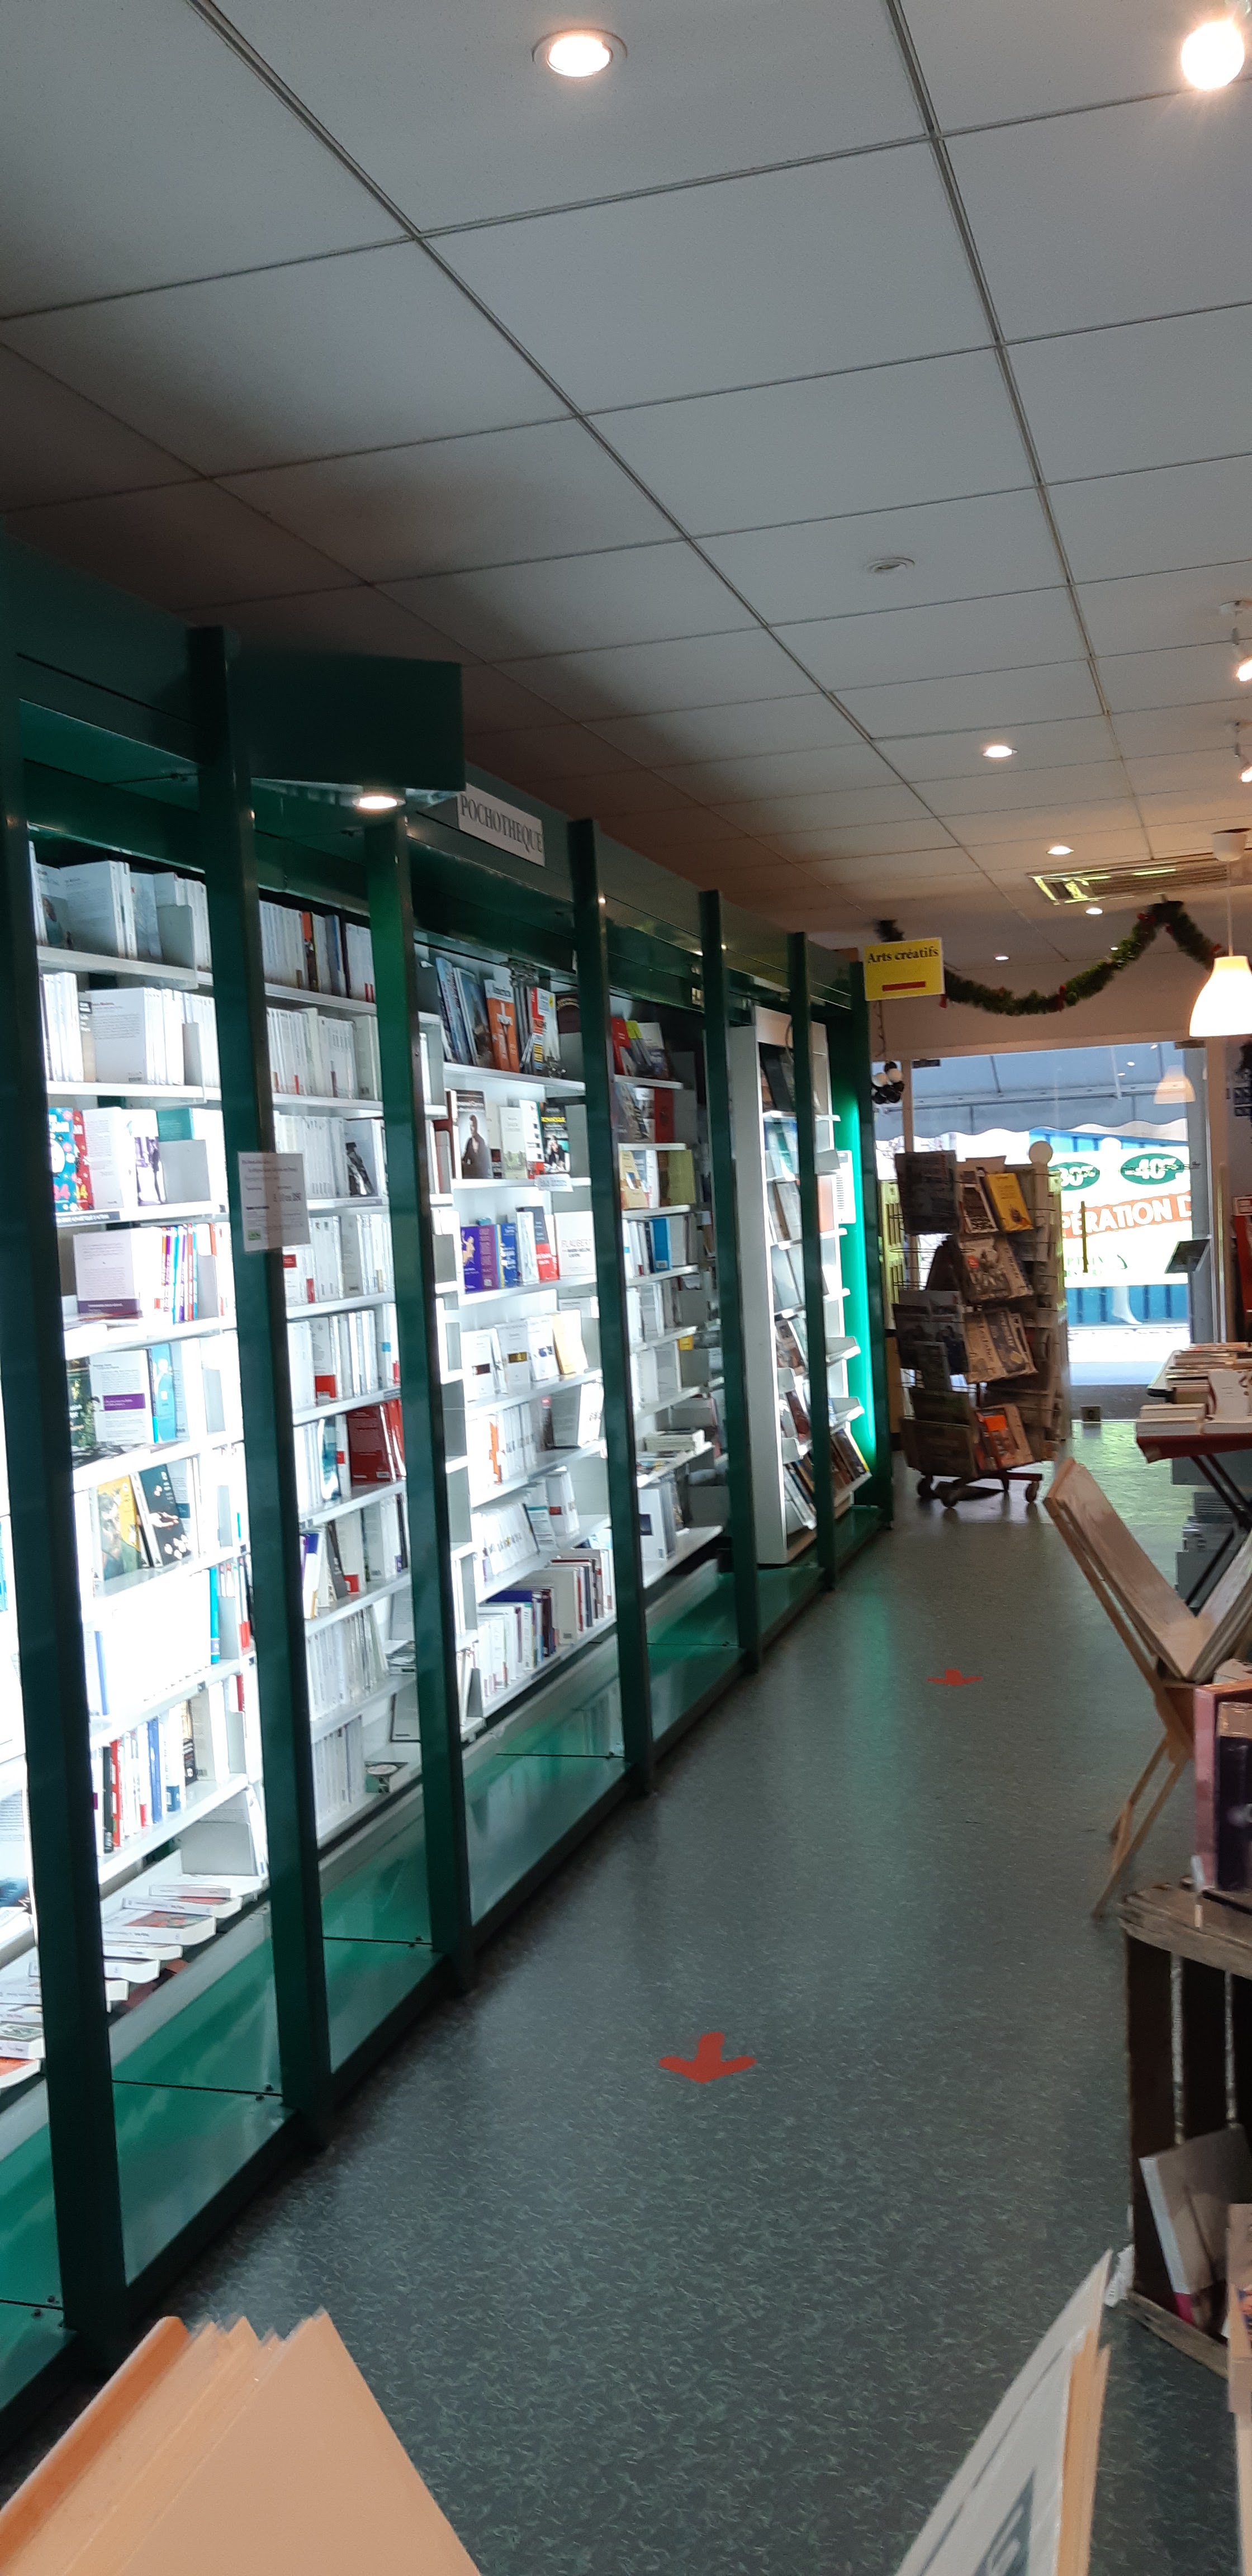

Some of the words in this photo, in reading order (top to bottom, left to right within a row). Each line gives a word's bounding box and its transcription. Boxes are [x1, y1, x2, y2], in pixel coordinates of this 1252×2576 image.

[461, 795, 542, 853] POCHOTHEQUE
[868, 953, 893, 964] Arts
[1061, 1198, 1173, 1235] PÉRATION
